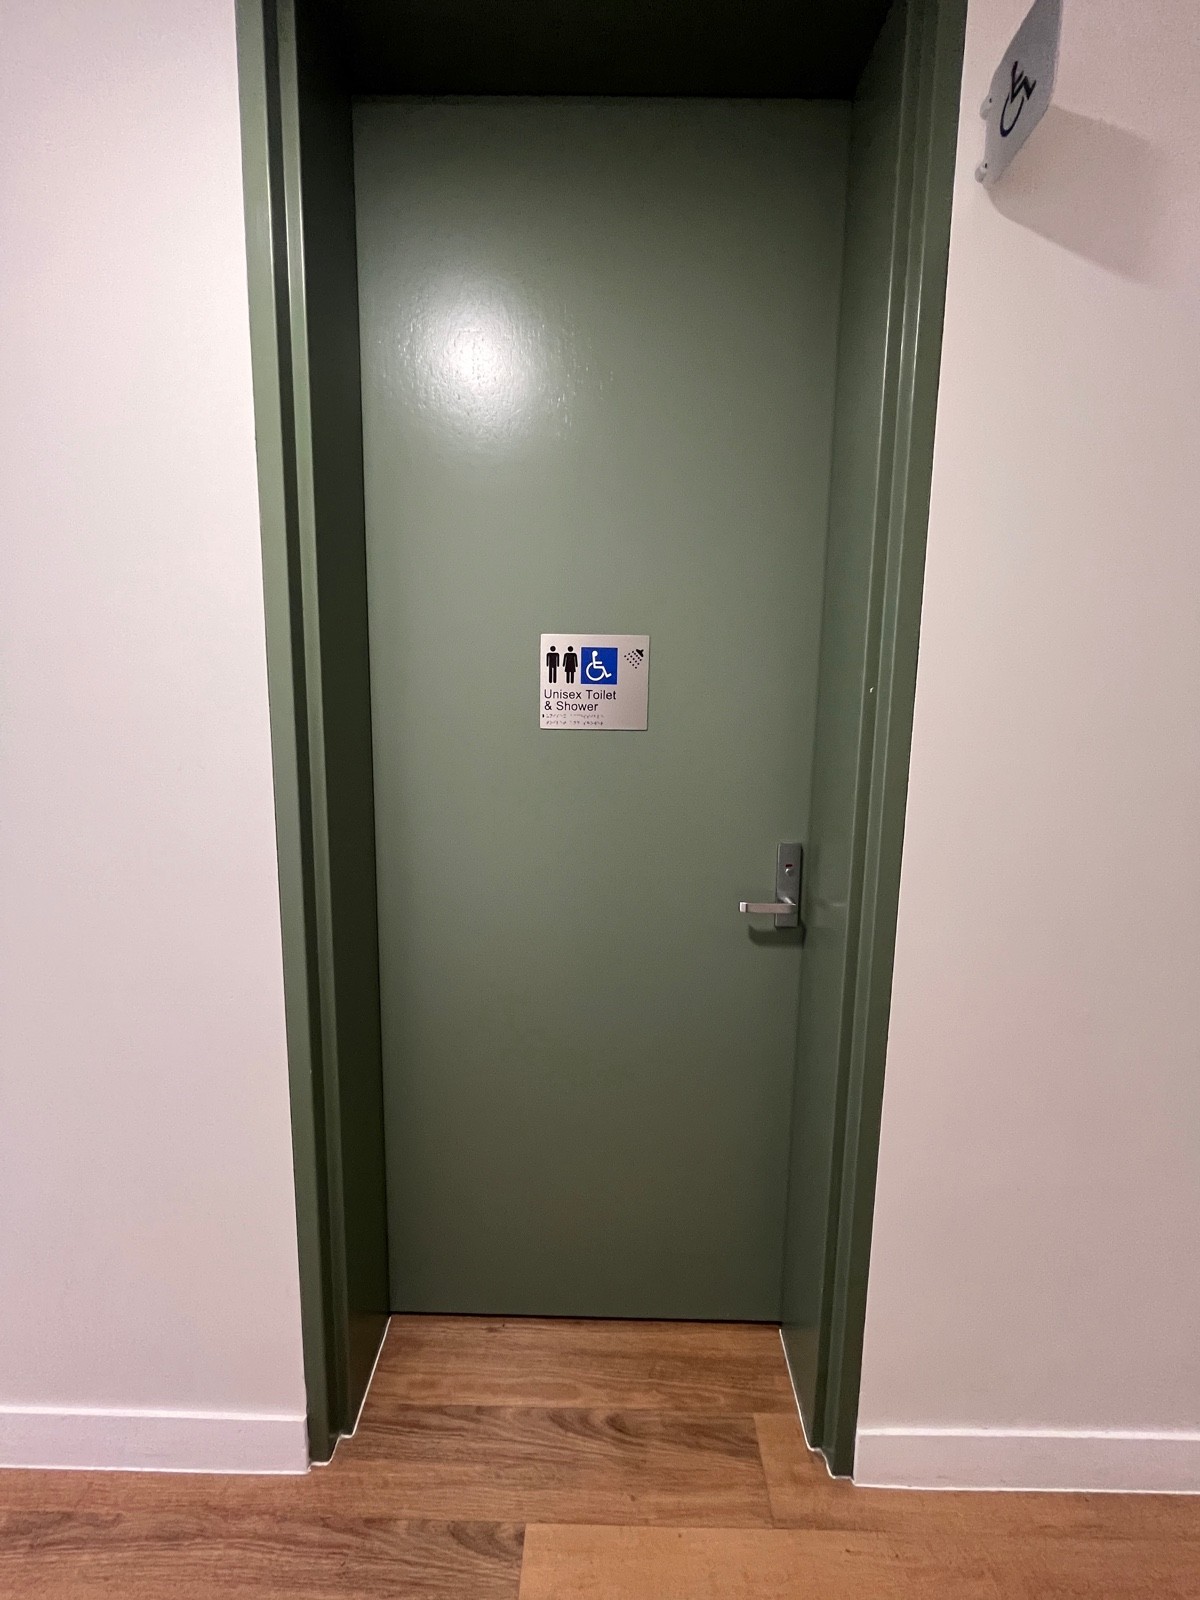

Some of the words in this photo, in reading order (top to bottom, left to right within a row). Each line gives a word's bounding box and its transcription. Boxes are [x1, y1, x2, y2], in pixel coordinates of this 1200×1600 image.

[544, 689, 582, 699] Unisex
[586, 689, 617, 700] Toilet
[544, 701, 552, 711] &
[556, 701, 598, 711] Shower
